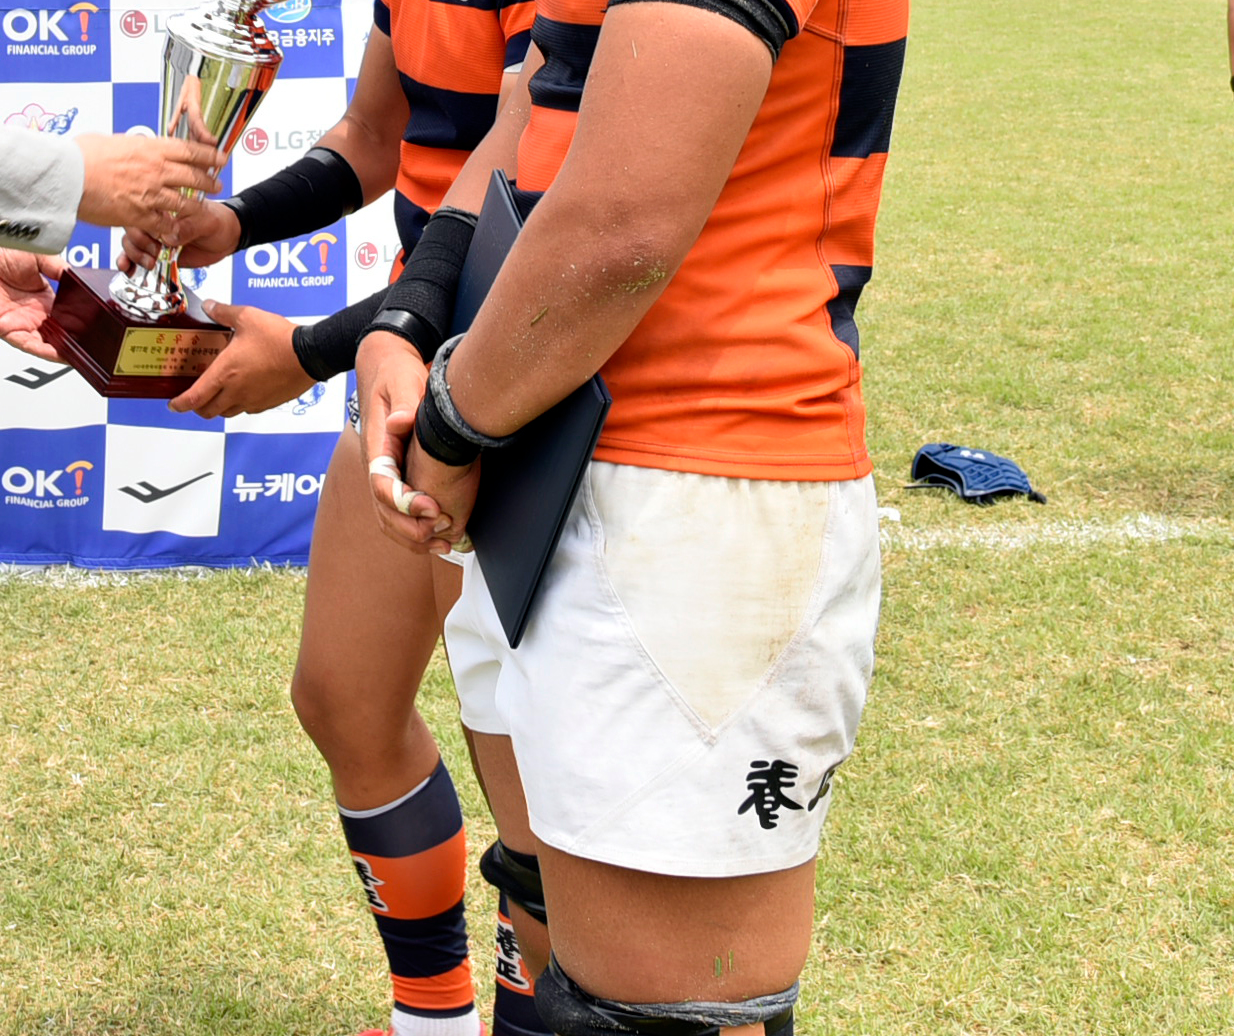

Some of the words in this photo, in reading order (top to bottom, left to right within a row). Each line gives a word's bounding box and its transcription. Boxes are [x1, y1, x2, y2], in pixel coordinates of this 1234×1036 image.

[268, 28, 335, 47] B금융지주
[7, 44, 60, 56] FINANCIAL
[62, 43, 97, 56] GROUP
[248, 277, 299, 288] FINANCIAL
[301, 275, 335, 287] GROUP
[232, 472, 326, 502] 뉴케어
[5, 495, 54, 509] FINANCIAL
[56, 496, 89, 508] GROUP
